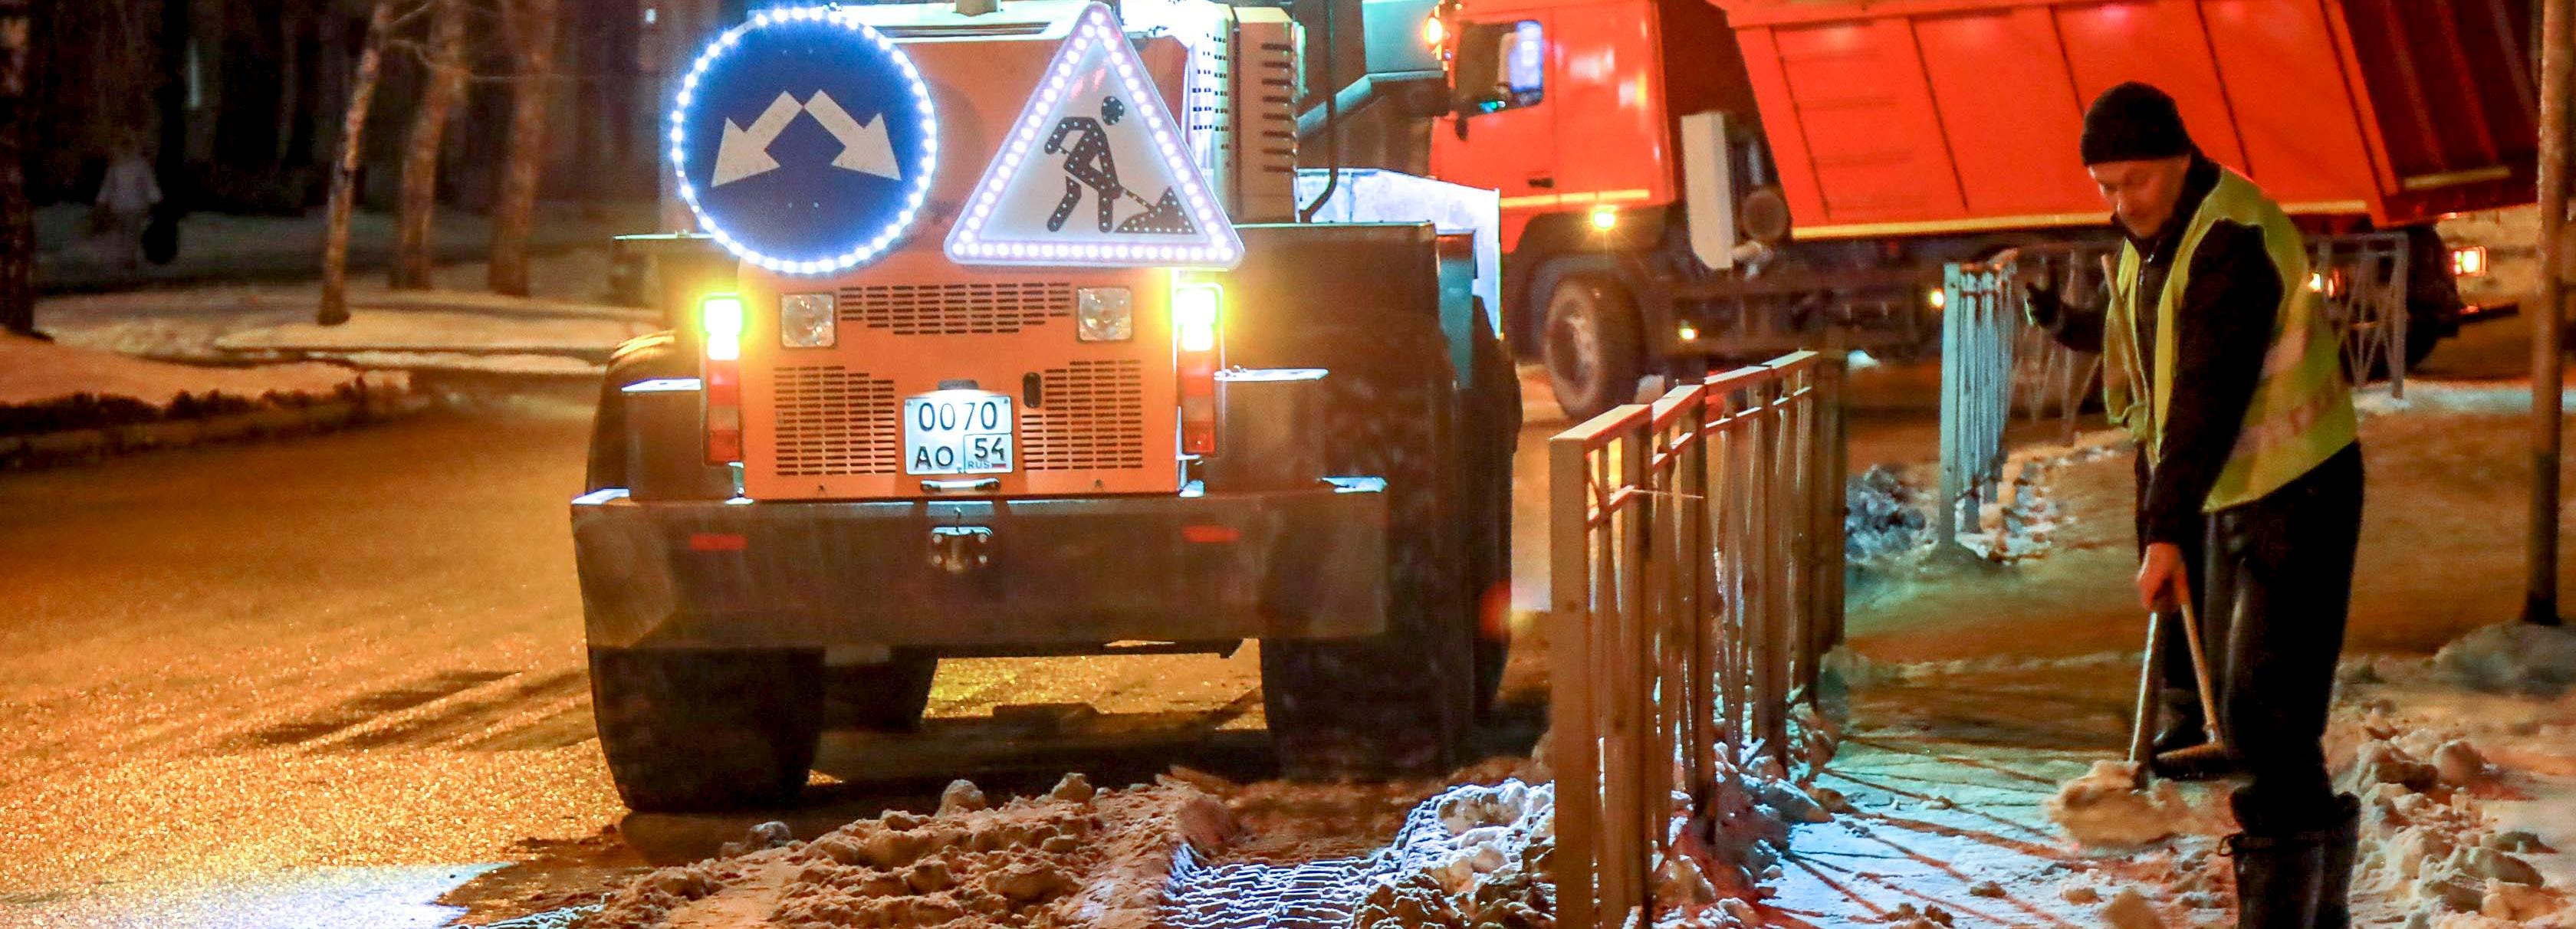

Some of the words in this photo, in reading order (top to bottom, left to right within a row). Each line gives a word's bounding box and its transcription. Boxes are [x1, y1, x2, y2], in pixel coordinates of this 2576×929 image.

[918, 402, 997, 432] 0070
[974, 437, 1005, 461] 54
[968, 461, 991, 469] RUS
